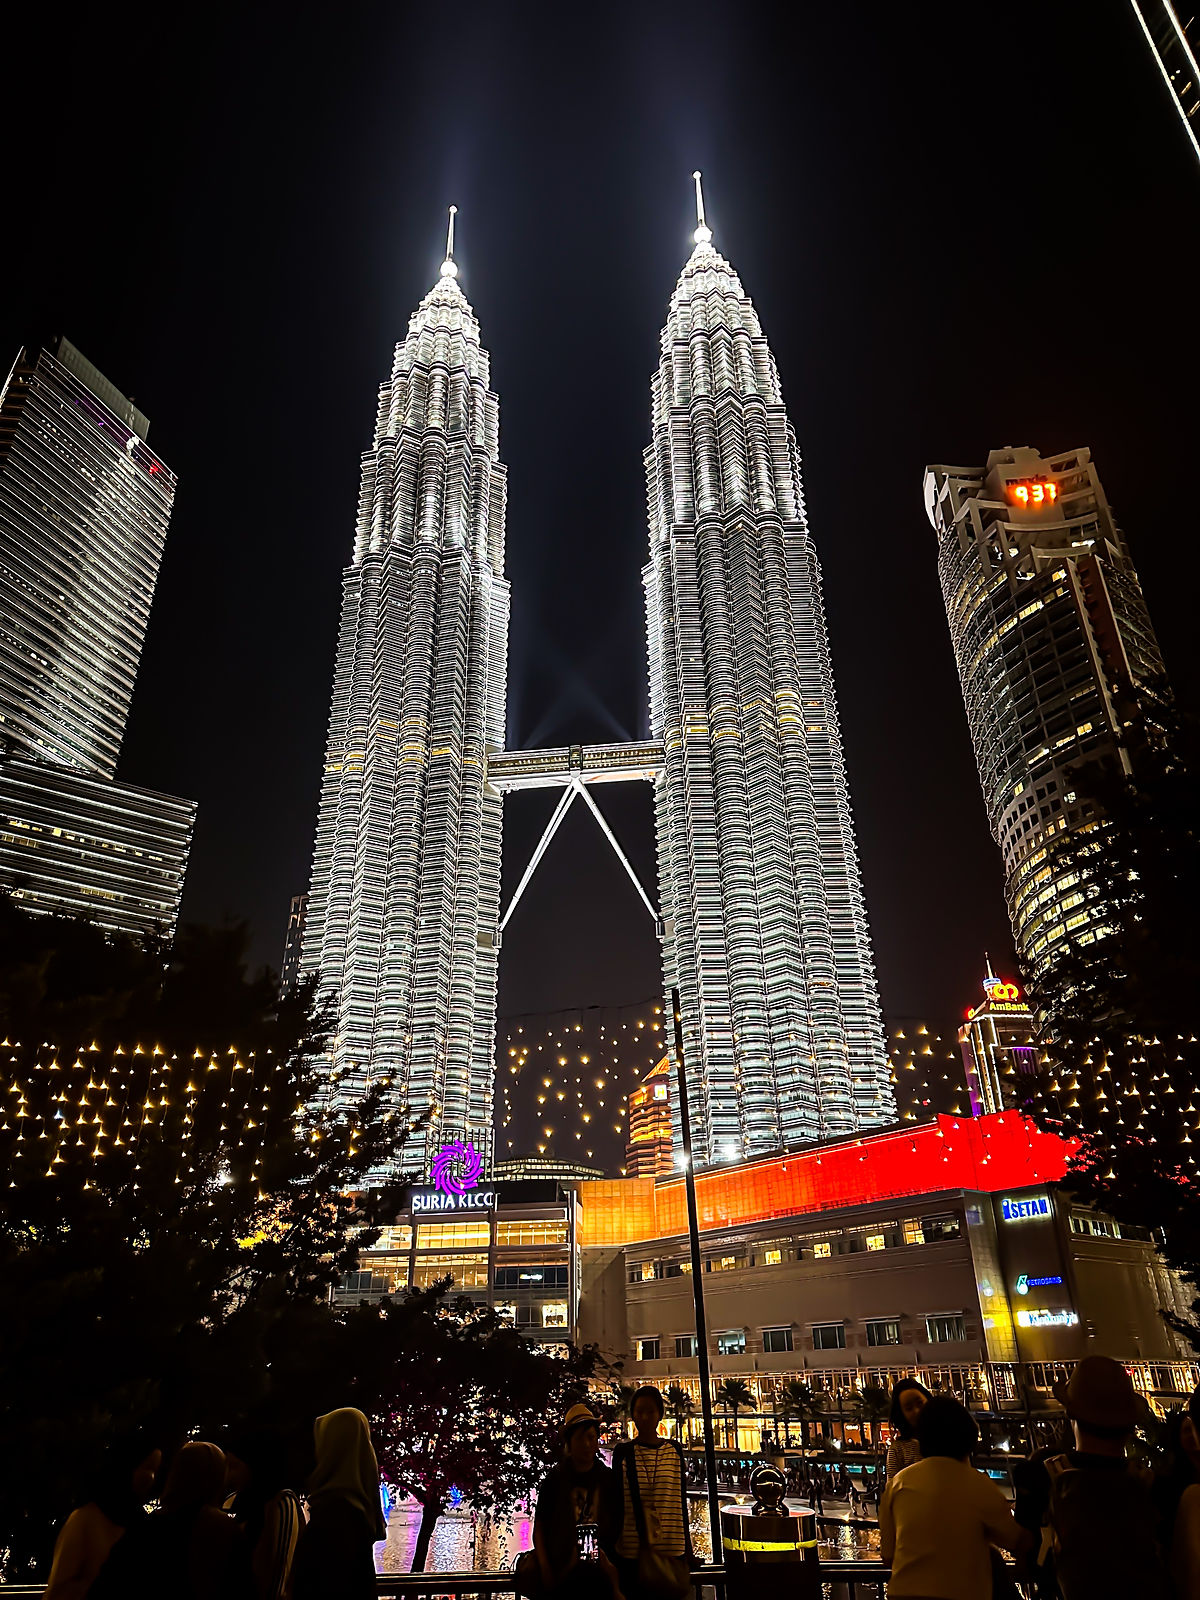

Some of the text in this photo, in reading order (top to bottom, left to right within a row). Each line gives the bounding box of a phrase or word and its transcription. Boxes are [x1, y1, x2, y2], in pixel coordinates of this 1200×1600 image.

[989, 1002, 1029, 1011] AmBank
[412, 1192, 494, 1210] SURIA KLCC
